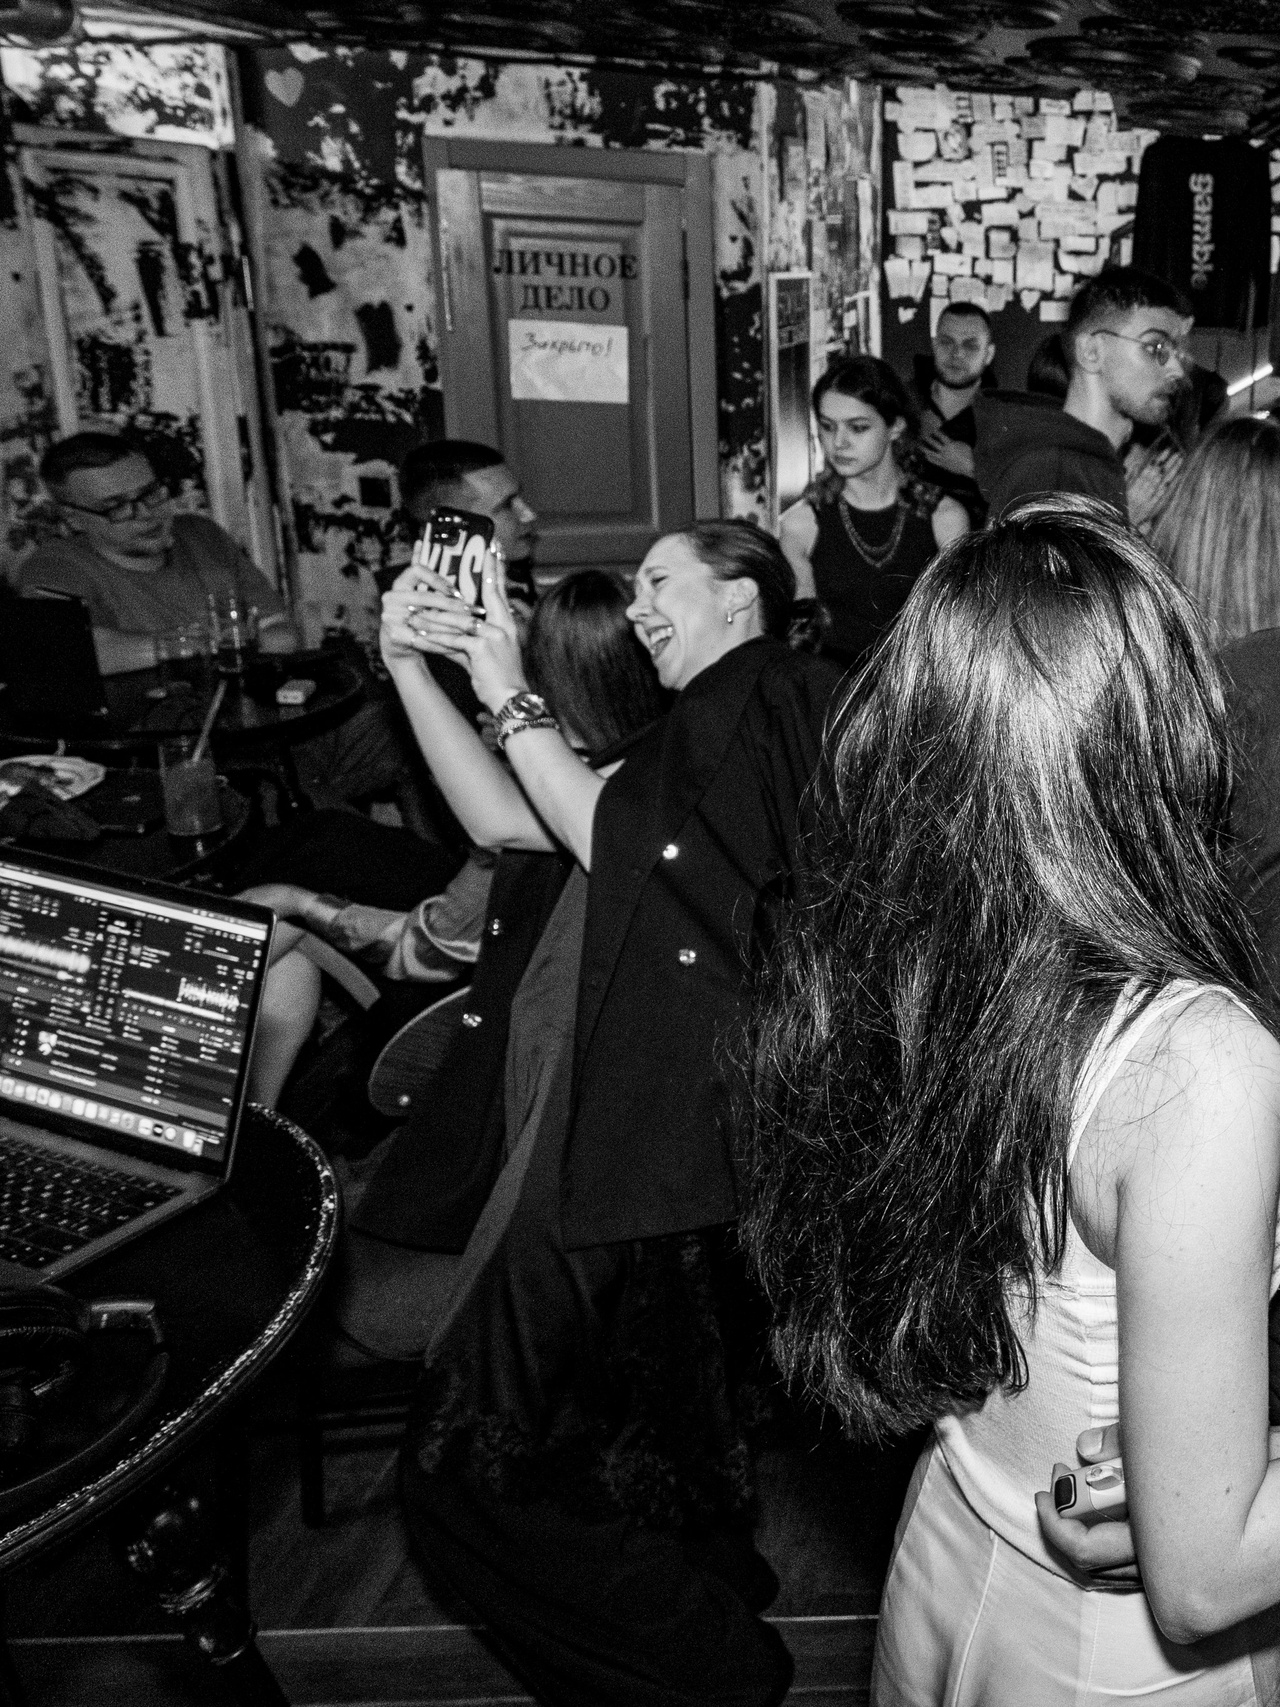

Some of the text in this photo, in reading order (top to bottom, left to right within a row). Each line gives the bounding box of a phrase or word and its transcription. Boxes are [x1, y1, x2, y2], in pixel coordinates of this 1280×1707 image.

[493, 249, 639, 280] ЛИЧНОЕ
[519, 283, 611, 313] ДЕЛО
[520, 331, 614, 358] Закрыто!
